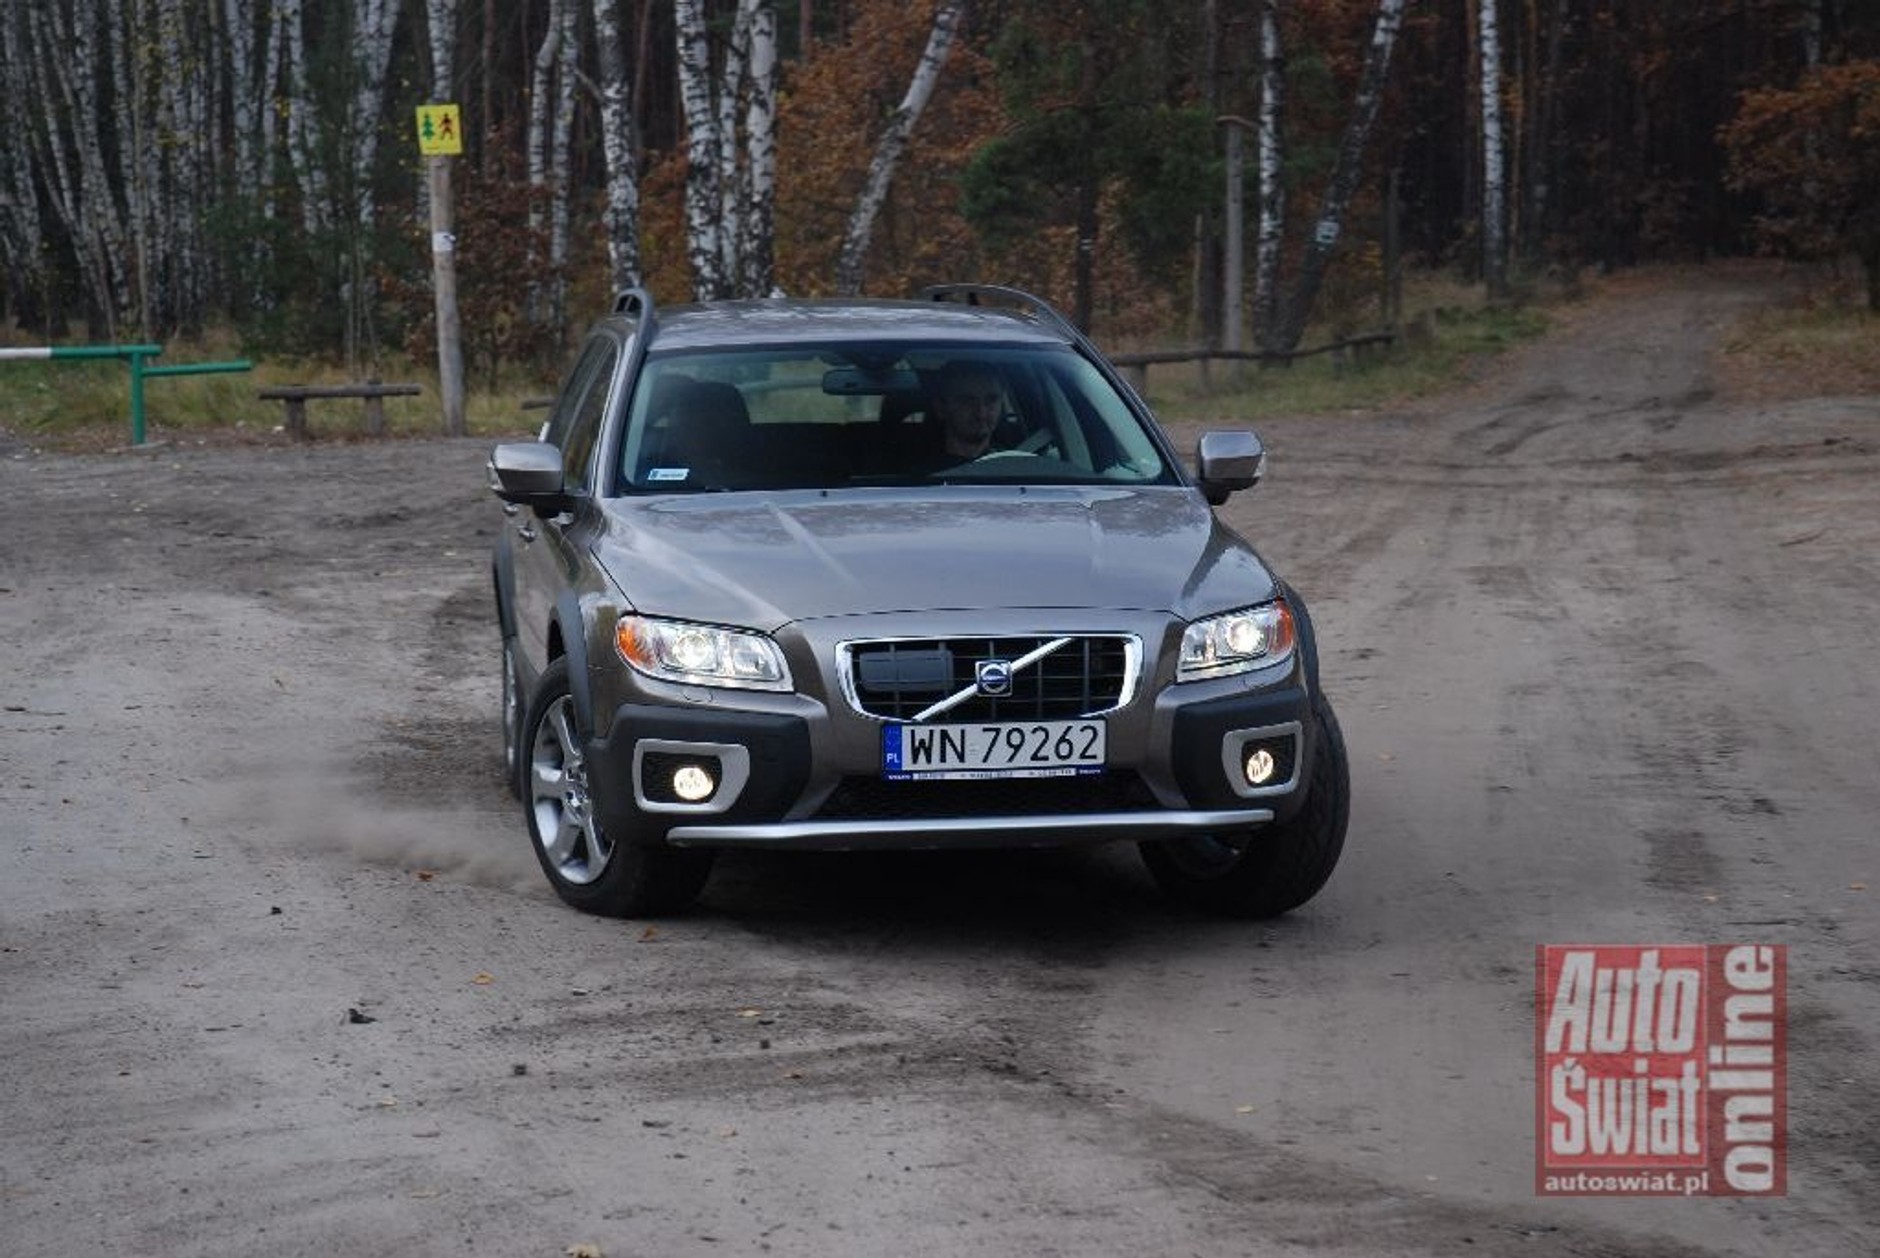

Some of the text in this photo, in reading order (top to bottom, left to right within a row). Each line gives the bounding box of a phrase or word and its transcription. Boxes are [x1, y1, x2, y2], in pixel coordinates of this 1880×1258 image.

[911, 725, 1099, 765] WN 79262
[887, 753, 900, 764] PL
